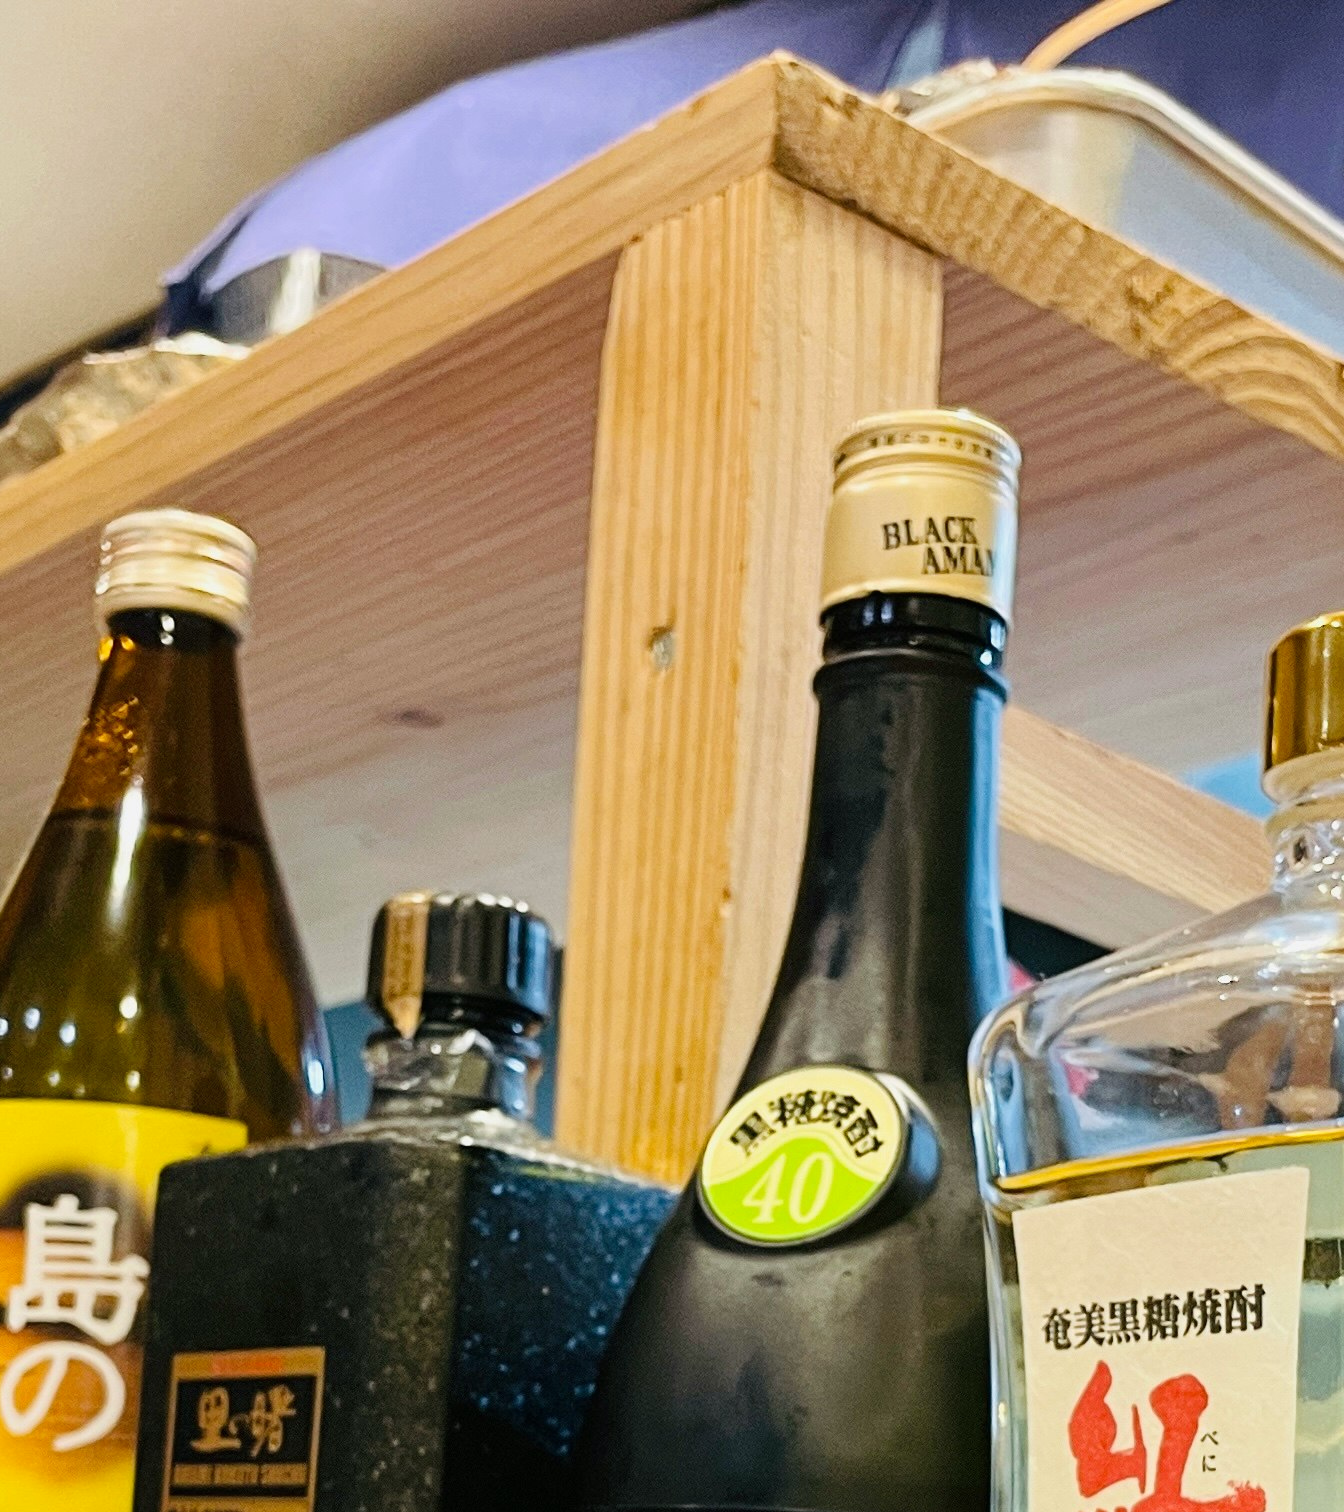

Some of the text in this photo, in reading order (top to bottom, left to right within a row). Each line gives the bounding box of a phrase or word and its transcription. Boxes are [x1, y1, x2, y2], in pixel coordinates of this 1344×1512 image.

[882, 516, 977, 551] BLACK
[742, 1151, 835, 1225] 40
[1041, 1282, 1267, 1352] 奄美黒糖焼酎
